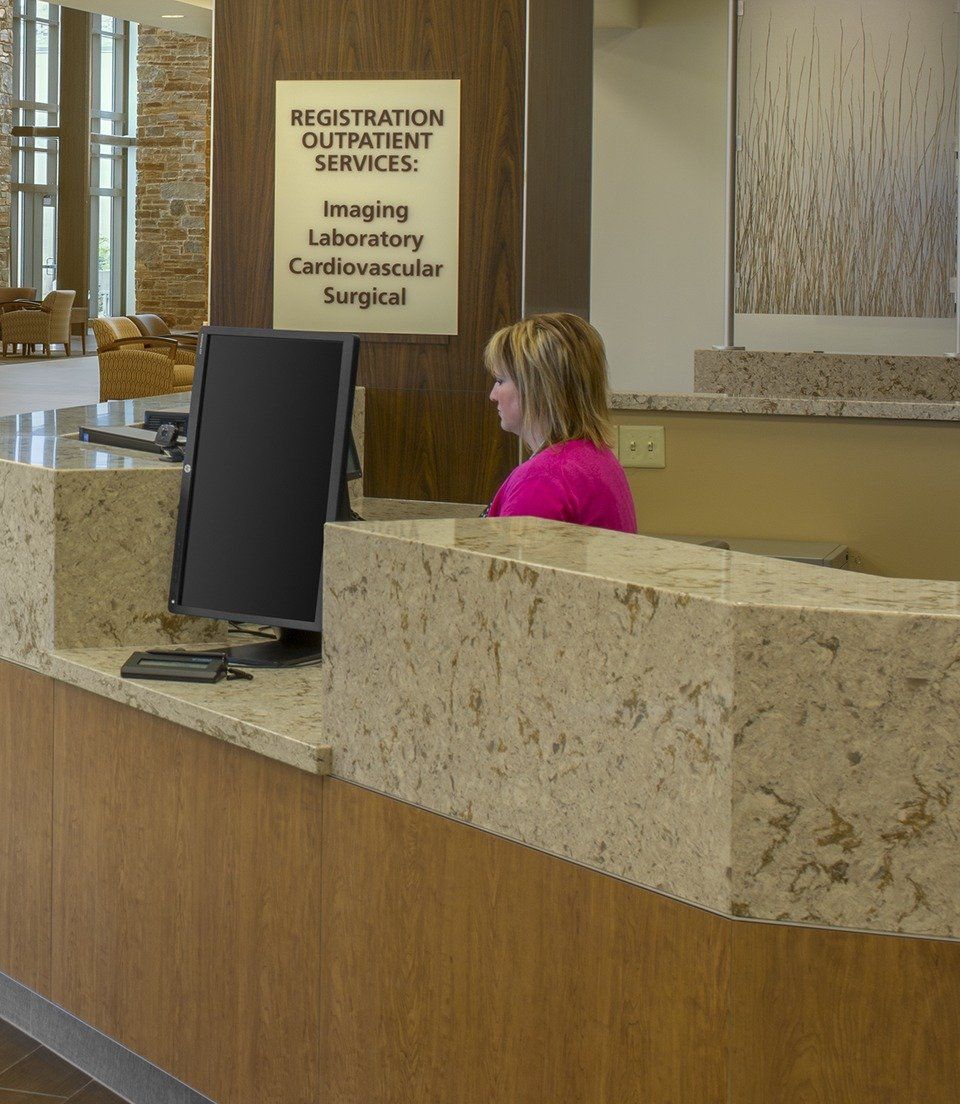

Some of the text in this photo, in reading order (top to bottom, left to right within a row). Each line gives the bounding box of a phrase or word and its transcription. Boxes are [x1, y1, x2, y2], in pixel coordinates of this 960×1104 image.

[291, 109, 444, 127] REGISTRATION
[301, 132, 433, 149] OUTPATIENT
[315, 154, 418, 172] SERVICES:
[323, 200, 409, 223] Imaging
[308, 228, 424, 252] Laboratory
[289, 257, 443, 278] Cardiovascular
[323, 286, 406, 310] Surgical
